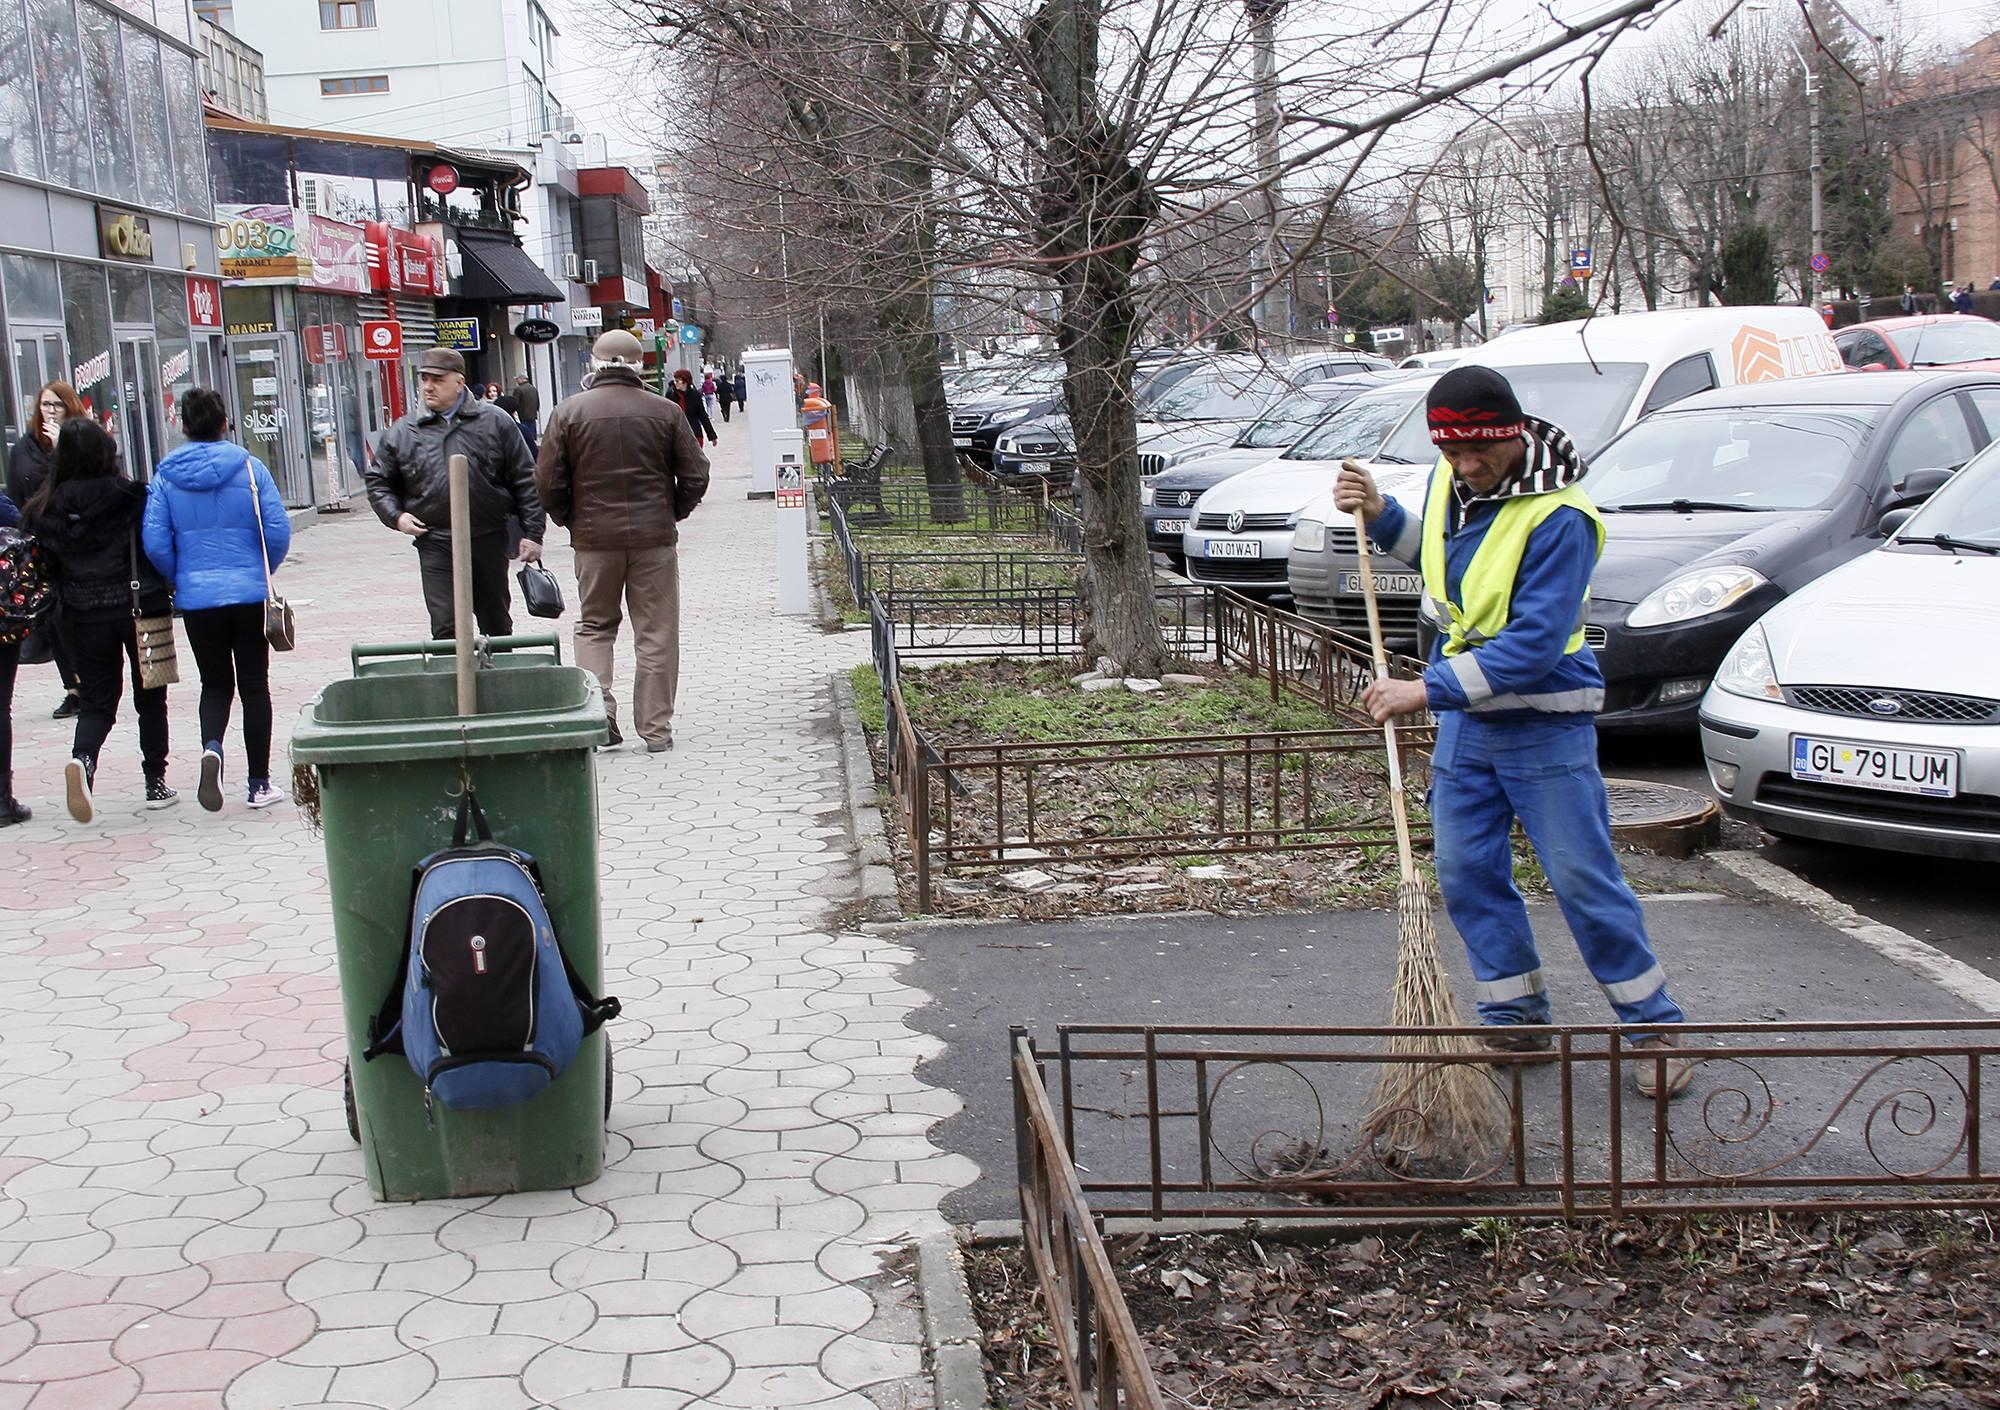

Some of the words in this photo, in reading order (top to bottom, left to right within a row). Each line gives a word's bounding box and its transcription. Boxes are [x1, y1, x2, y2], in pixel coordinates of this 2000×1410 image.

[234, 258, 273, 267] AMANET
[223, 269, 247, 277] BANI
[432, 320, 475, 329] AMANET
[367, 347, 400, 355] Stanleybet
[1779, 332, 1841, 377] ZEUS
[1210, 542, 1223, 555] VN
[1812, 744, 1844, 774] GL
